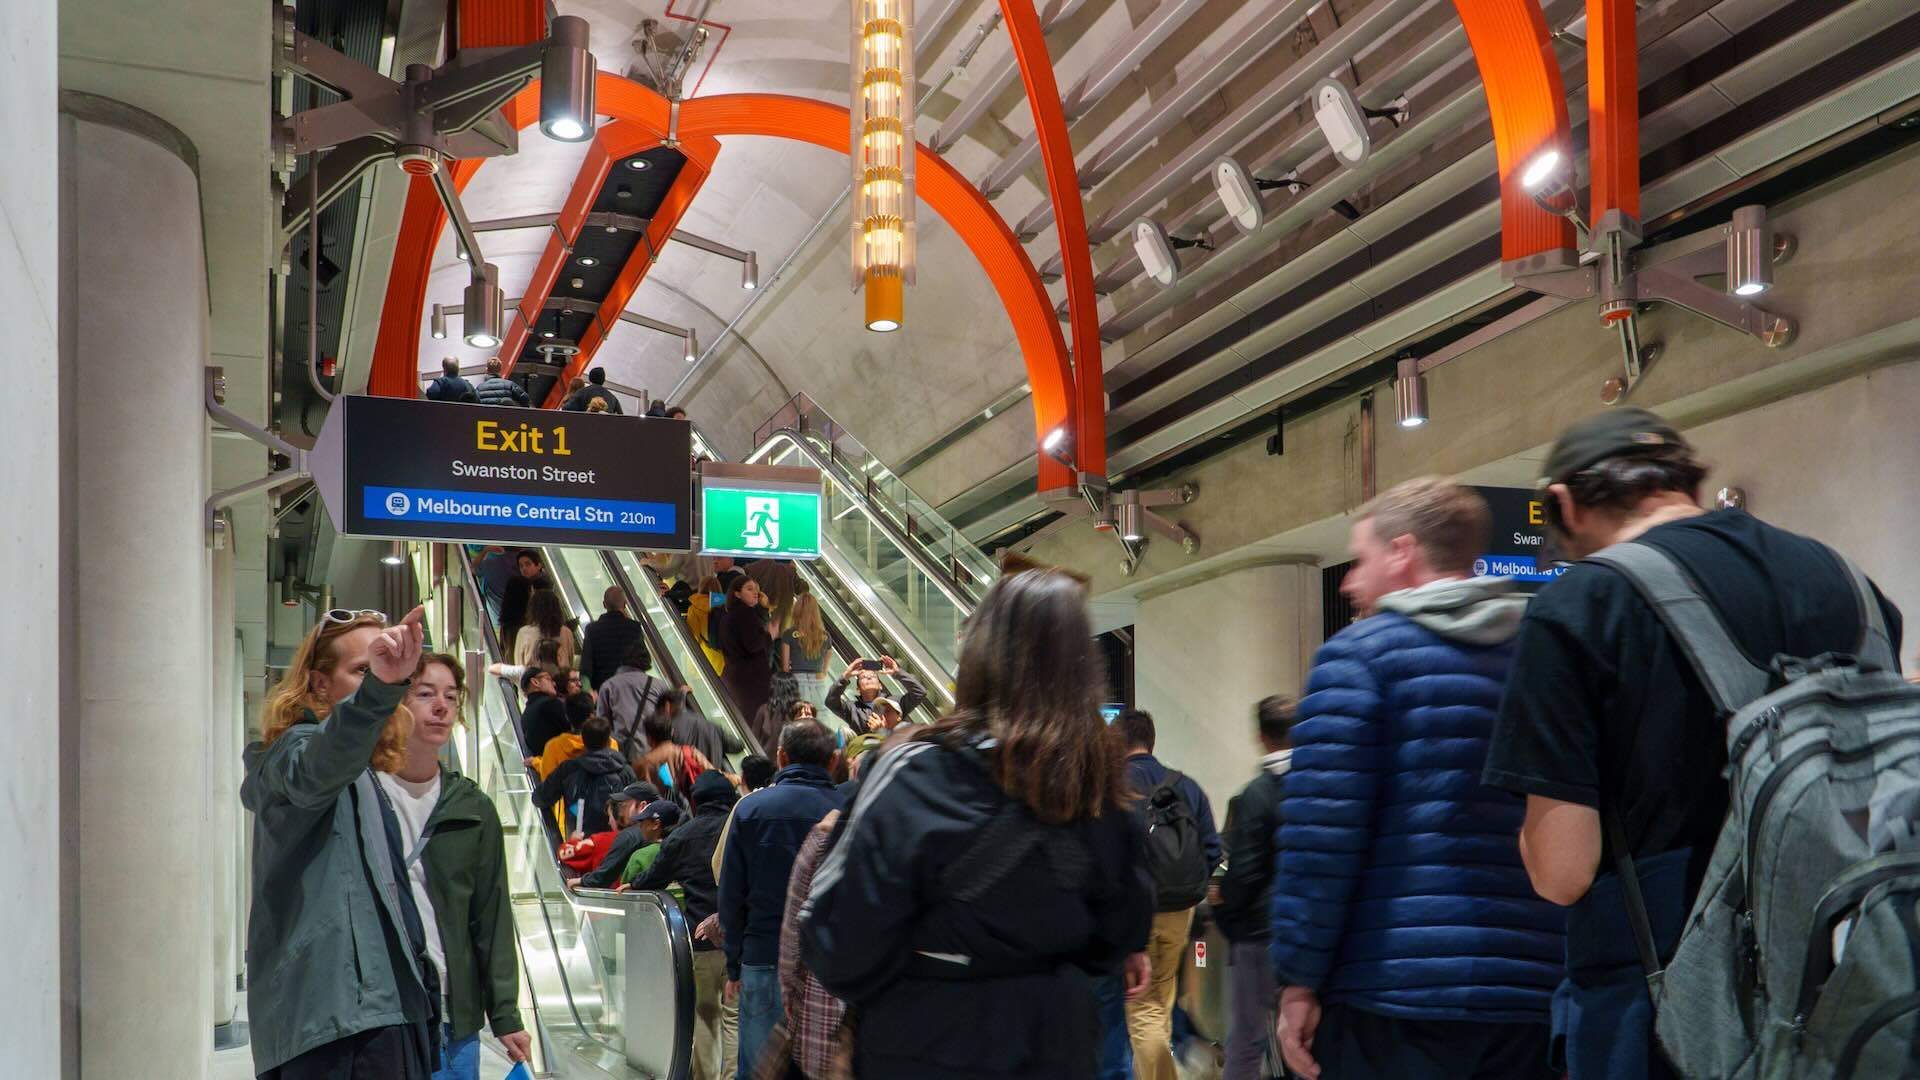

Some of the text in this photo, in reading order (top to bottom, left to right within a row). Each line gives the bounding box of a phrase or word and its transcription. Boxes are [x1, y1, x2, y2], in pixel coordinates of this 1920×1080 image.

[476, 420, 572, 456] Exit 1
[451, 460, 596, 484] Swanston Street
[417, 498, 656, 525] Melbourne Central Stn 210m
